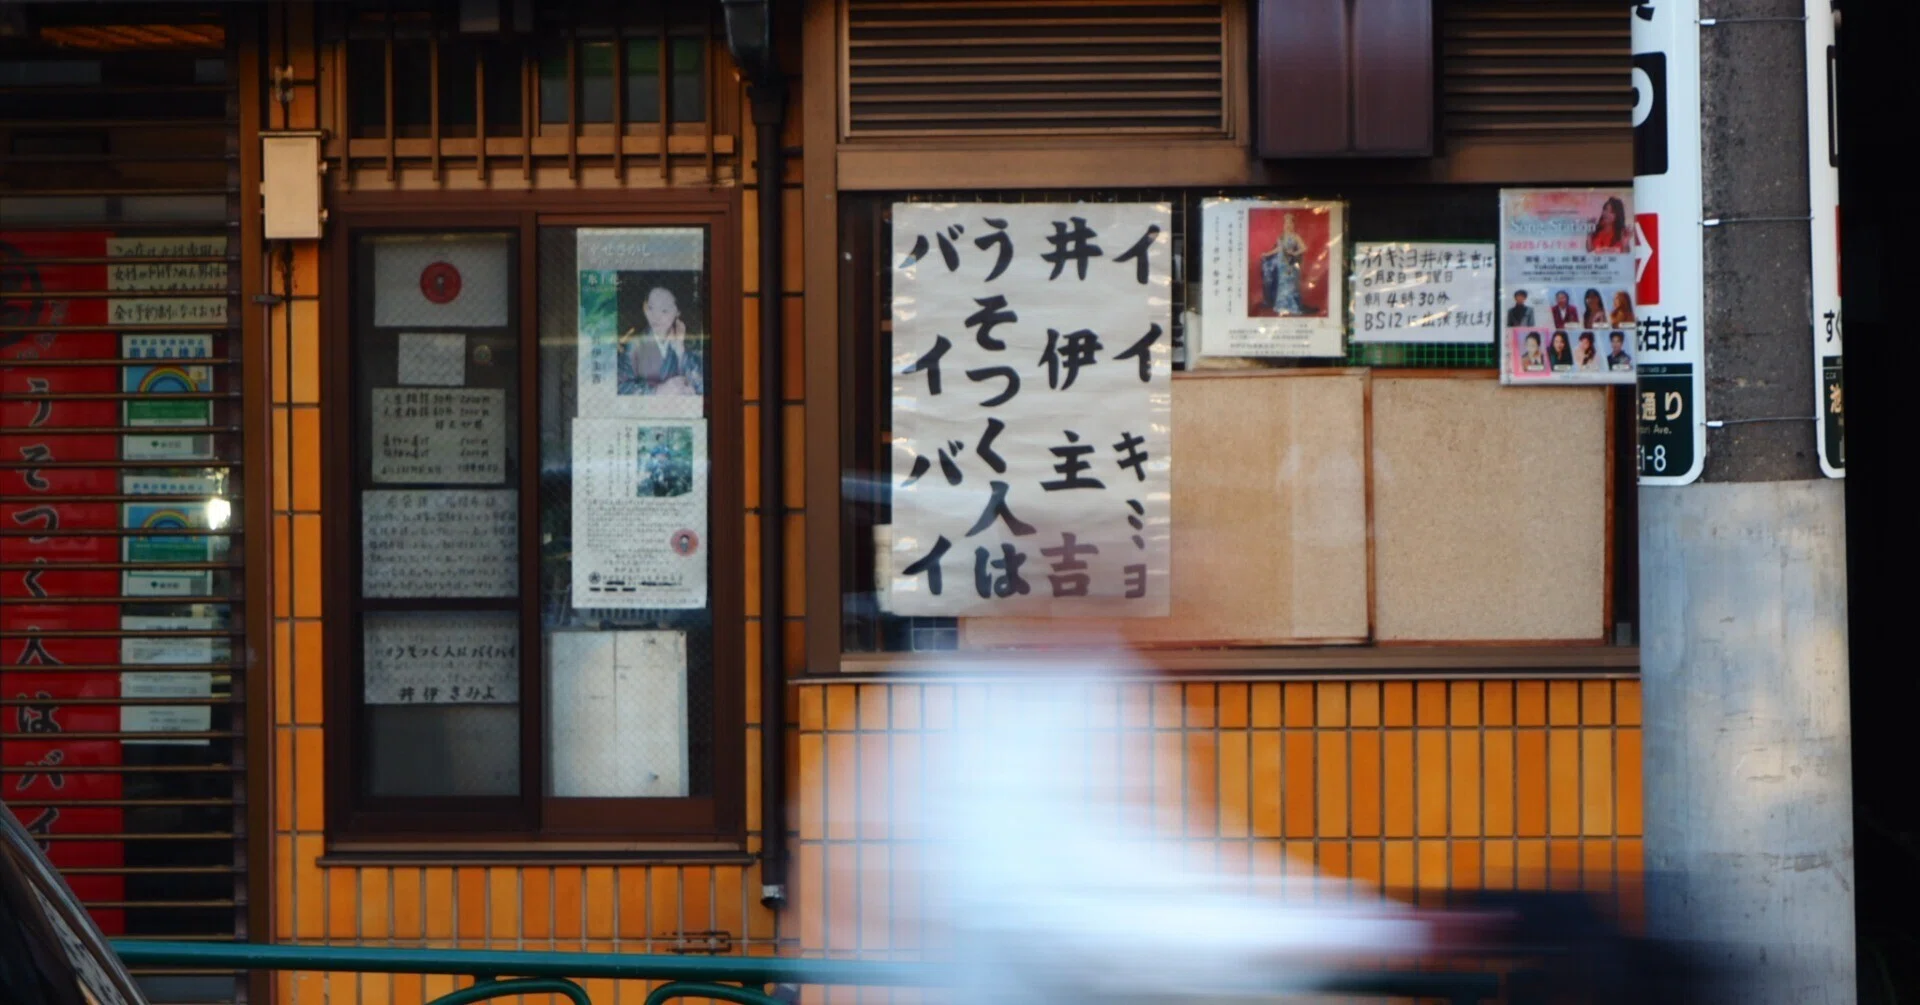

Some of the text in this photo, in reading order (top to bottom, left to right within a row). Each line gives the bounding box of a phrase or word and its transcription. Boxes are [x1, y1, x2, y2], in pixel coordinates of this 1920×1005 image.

[898, 223, 965, 596] バイバイ
[964, 217, 1037, 599] うそつく人は
[1038, 217, 1106, 598] 井伊主吉
[1112, 224, 1164, 599] イイキミヨ
[1636, 390, 1683, 421] 通り
[1636, 444, 1667, 472] 1-8
